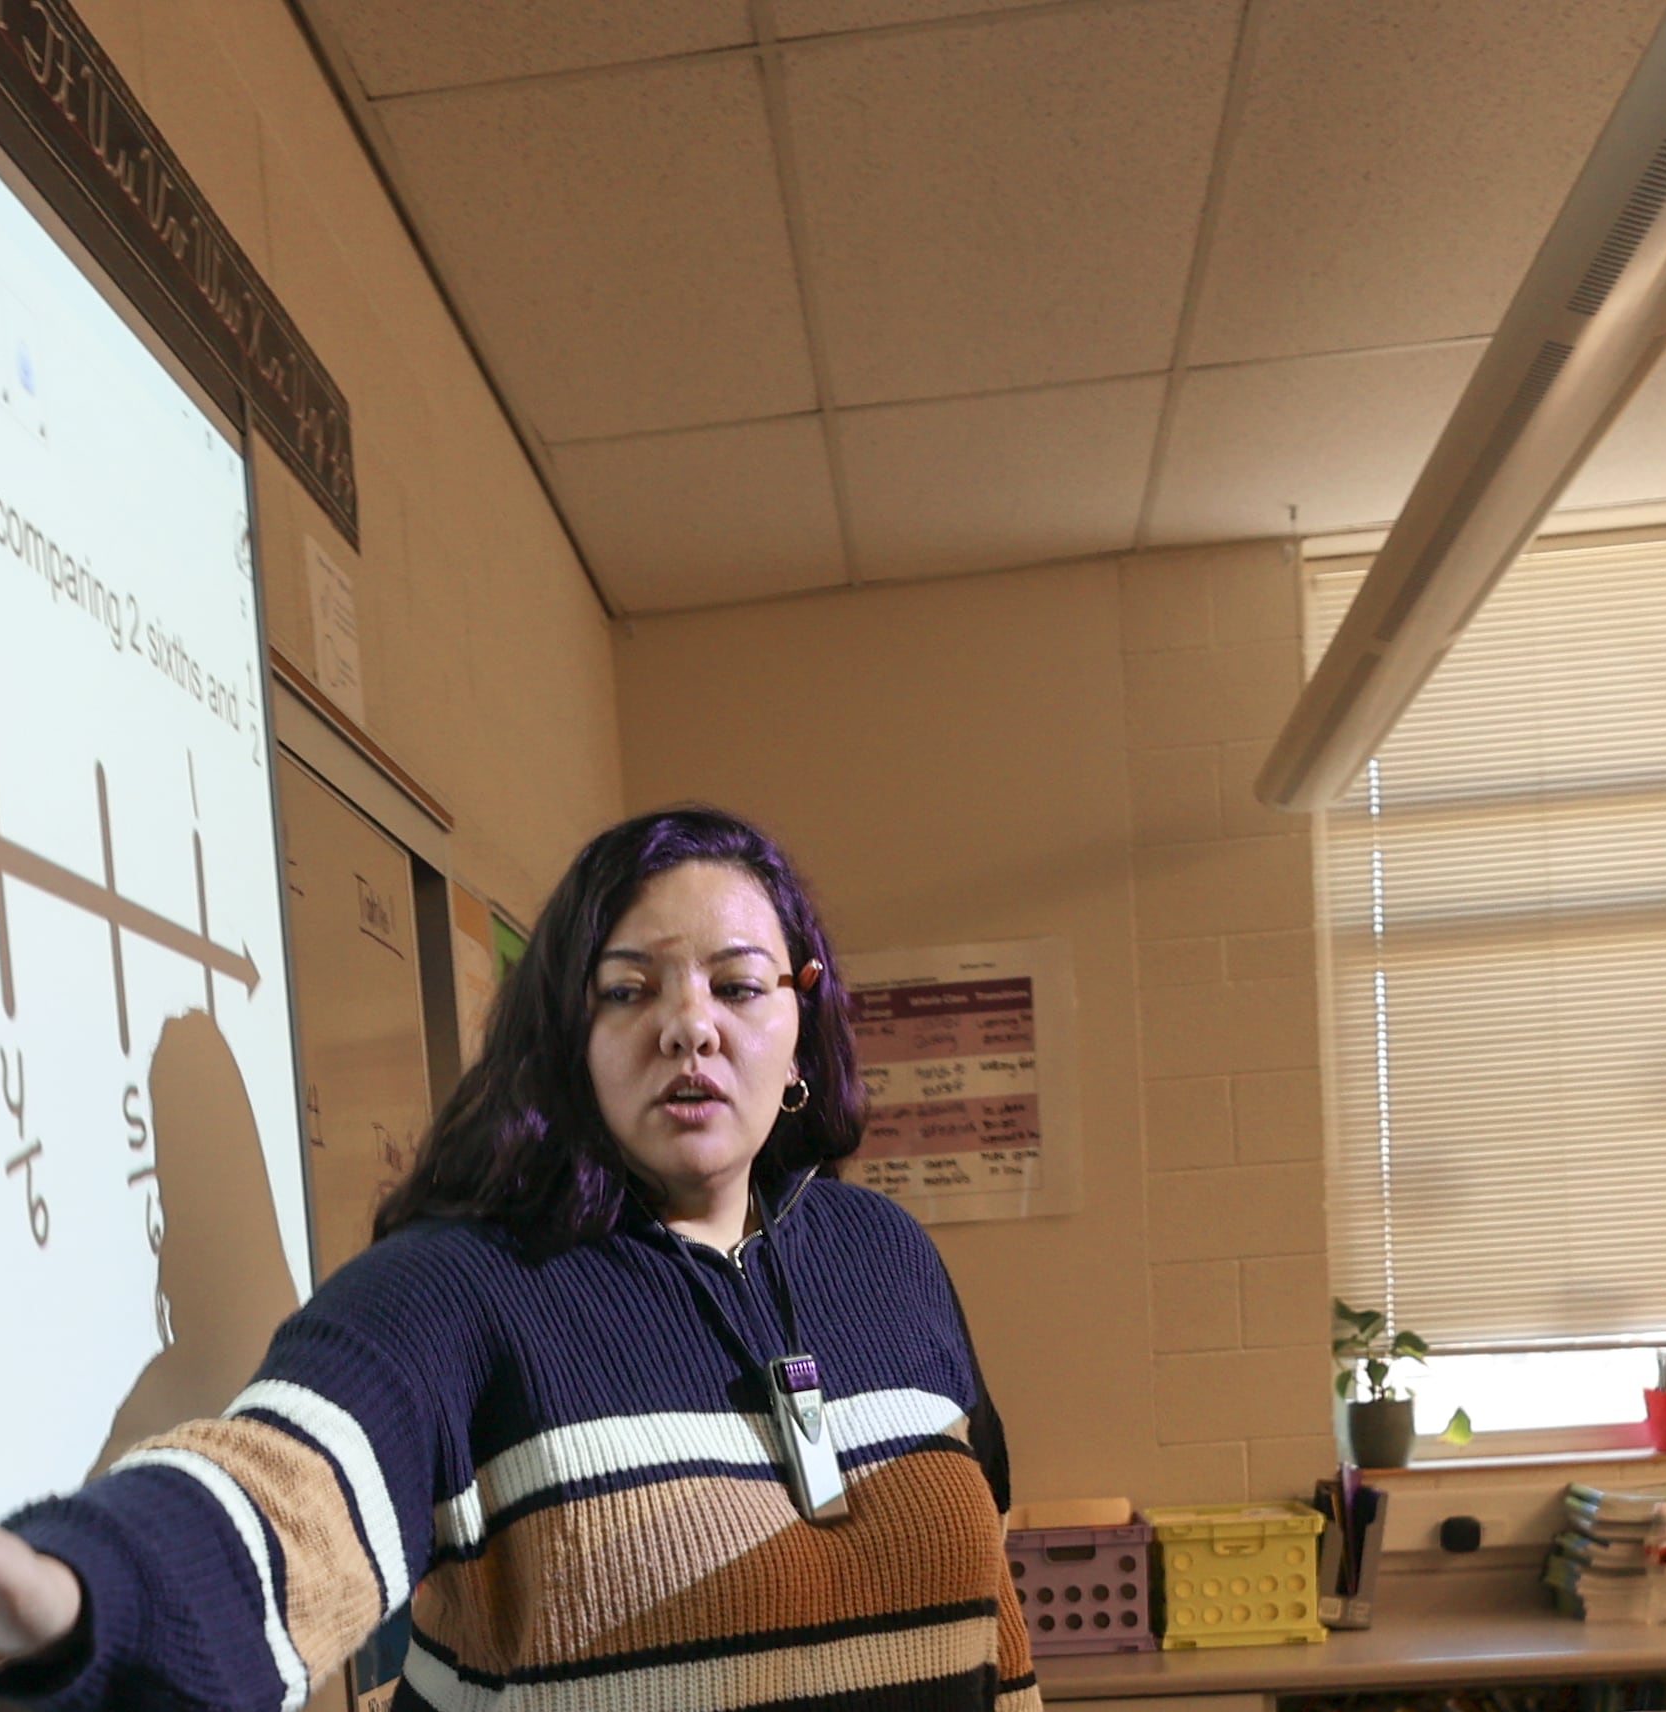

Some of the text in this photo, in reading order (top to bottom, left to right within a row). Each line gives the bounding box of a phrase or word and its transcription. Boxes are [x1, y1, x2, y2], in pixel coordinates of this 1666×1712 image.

[126, 593, 142, 654] 2
[146, 616, 203, 703] sixths
[207, 673, 240, 732] and
[0, 1045, 25, 1141] 4
[26, 1158, 49, 1249] 6
